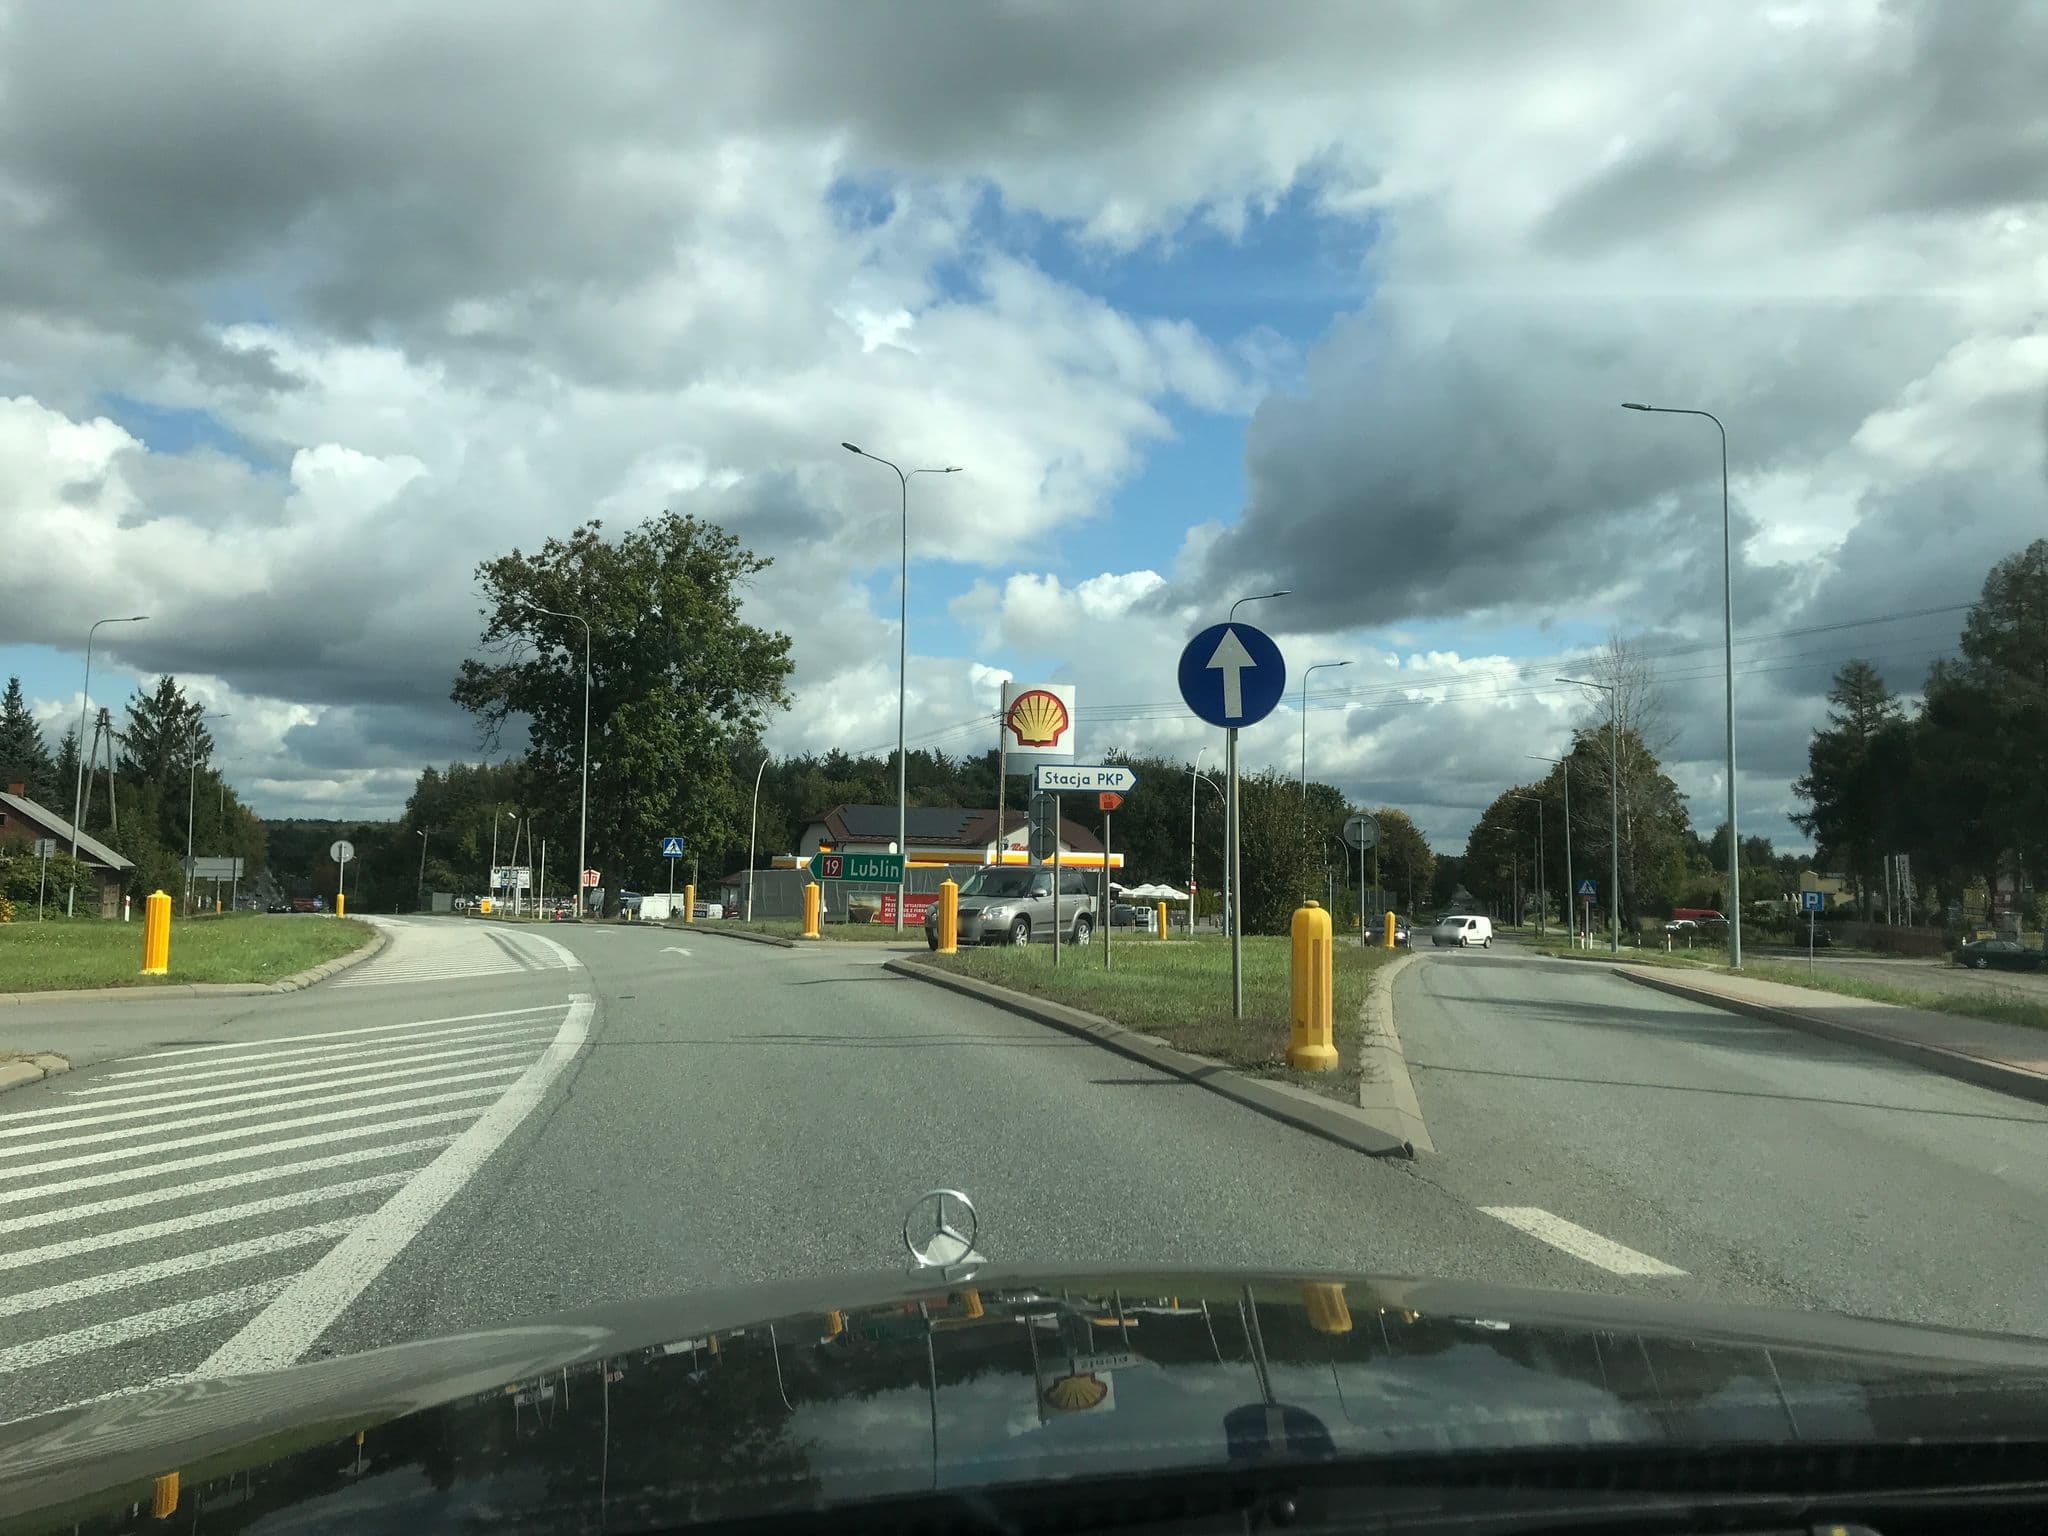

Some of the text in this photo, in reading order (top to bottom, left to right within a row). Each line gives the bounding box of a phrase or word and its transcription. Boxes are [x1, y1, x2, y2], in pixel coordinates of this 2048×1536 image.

[1044, 771, 1124, 788] Stacja PKP
[826, 858, 899, 878] 19 Lublin
